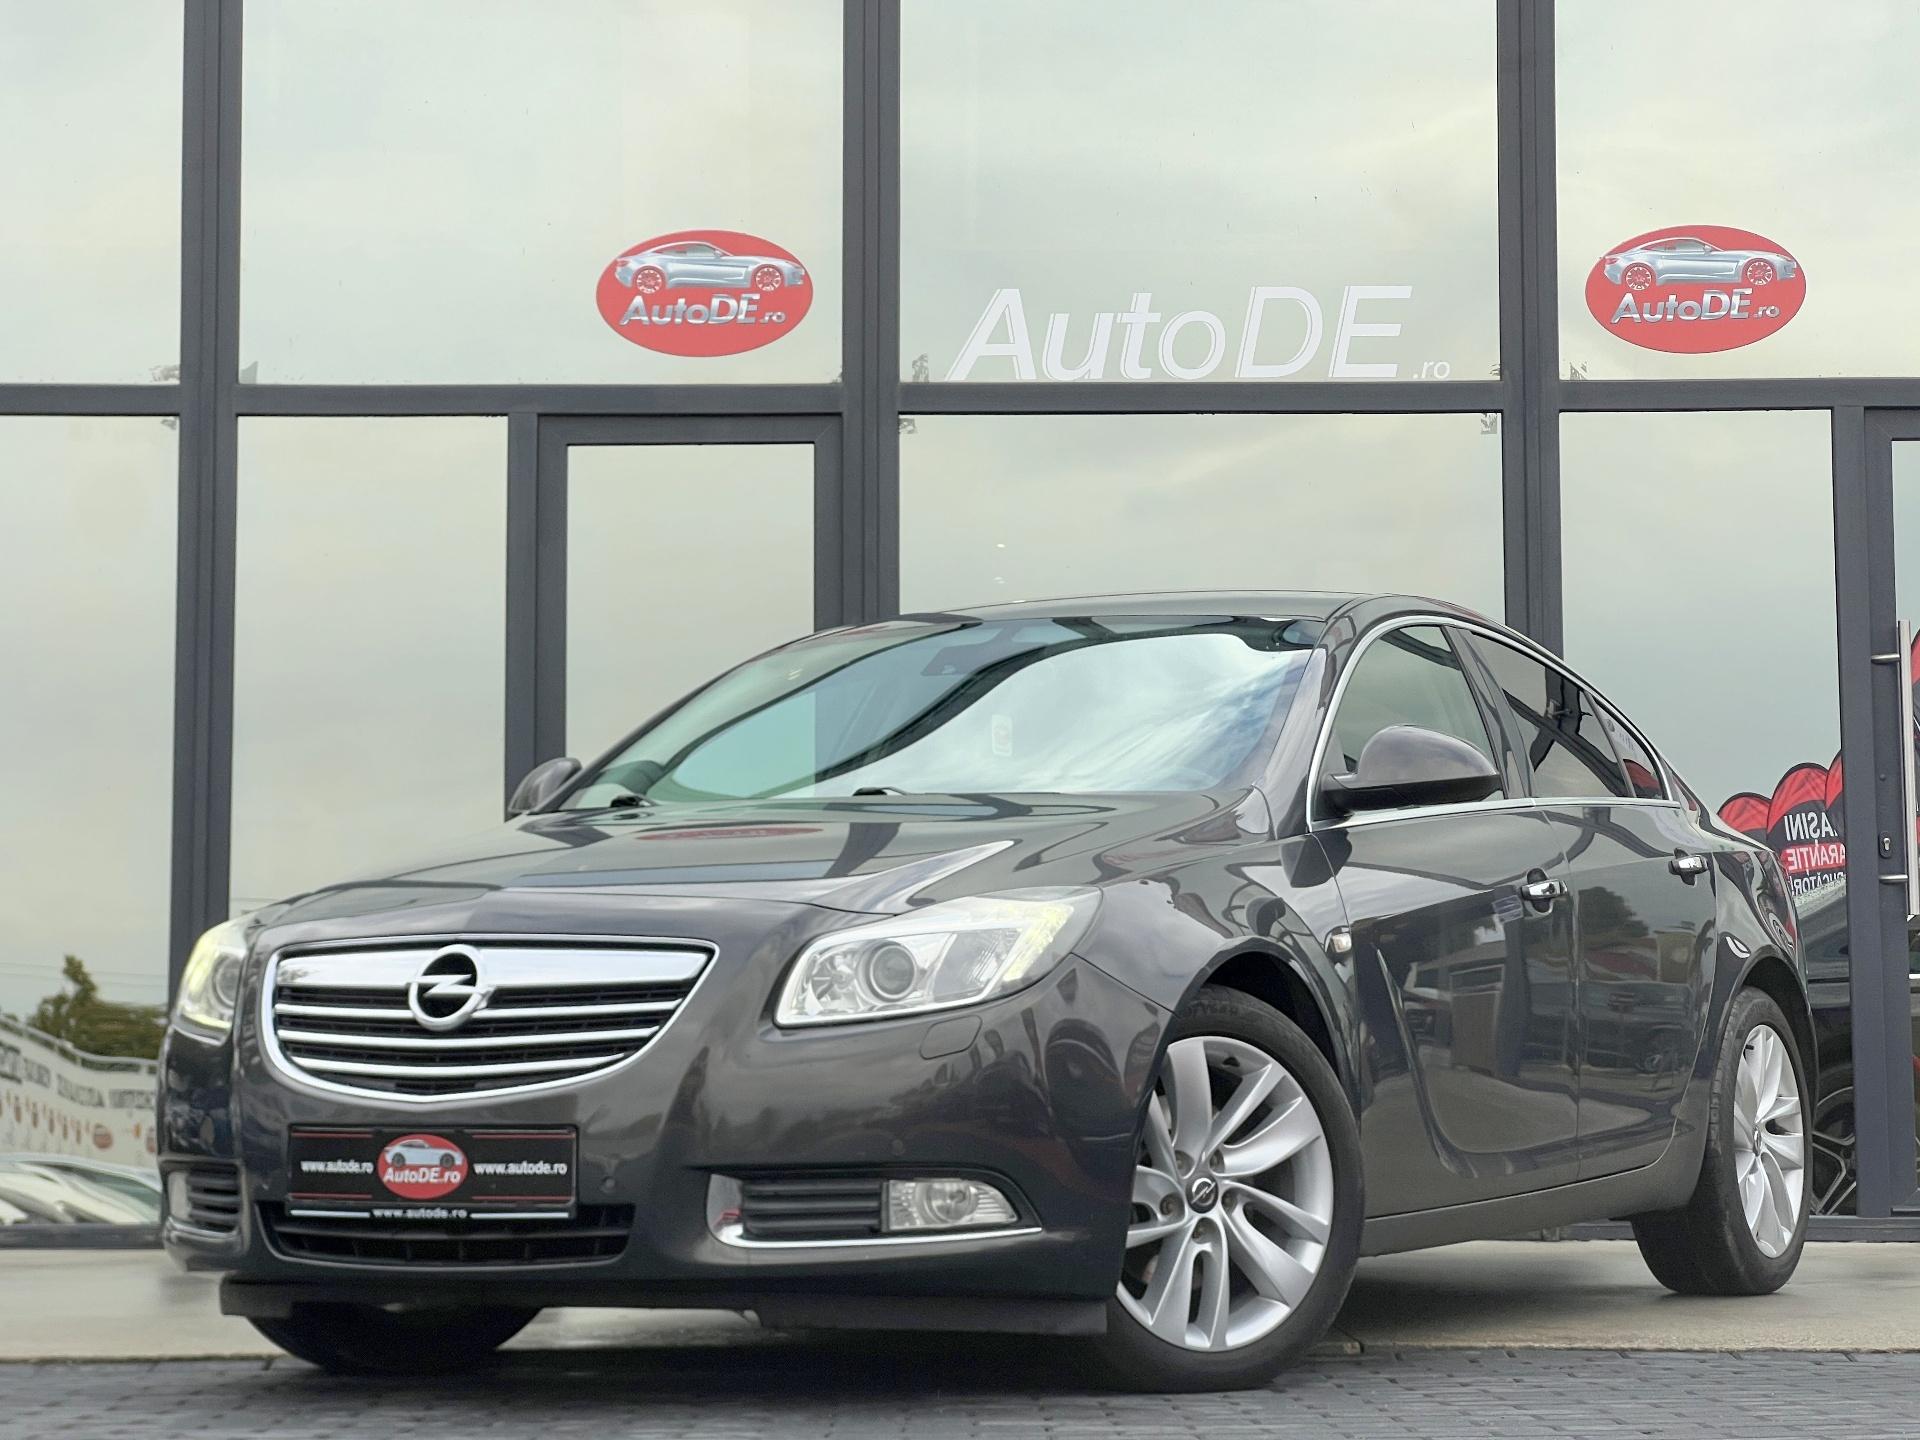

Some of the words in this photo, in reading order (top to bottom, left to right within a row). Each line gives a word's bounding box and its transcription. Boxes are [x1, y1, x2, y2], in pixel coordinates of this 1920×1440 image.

[300, 1159, 374, 1174] www.autode.ro
[473, 1160, 568, 1175] www.autode.ro
[383, 1166, 461, 1184] AutoDE.ro
